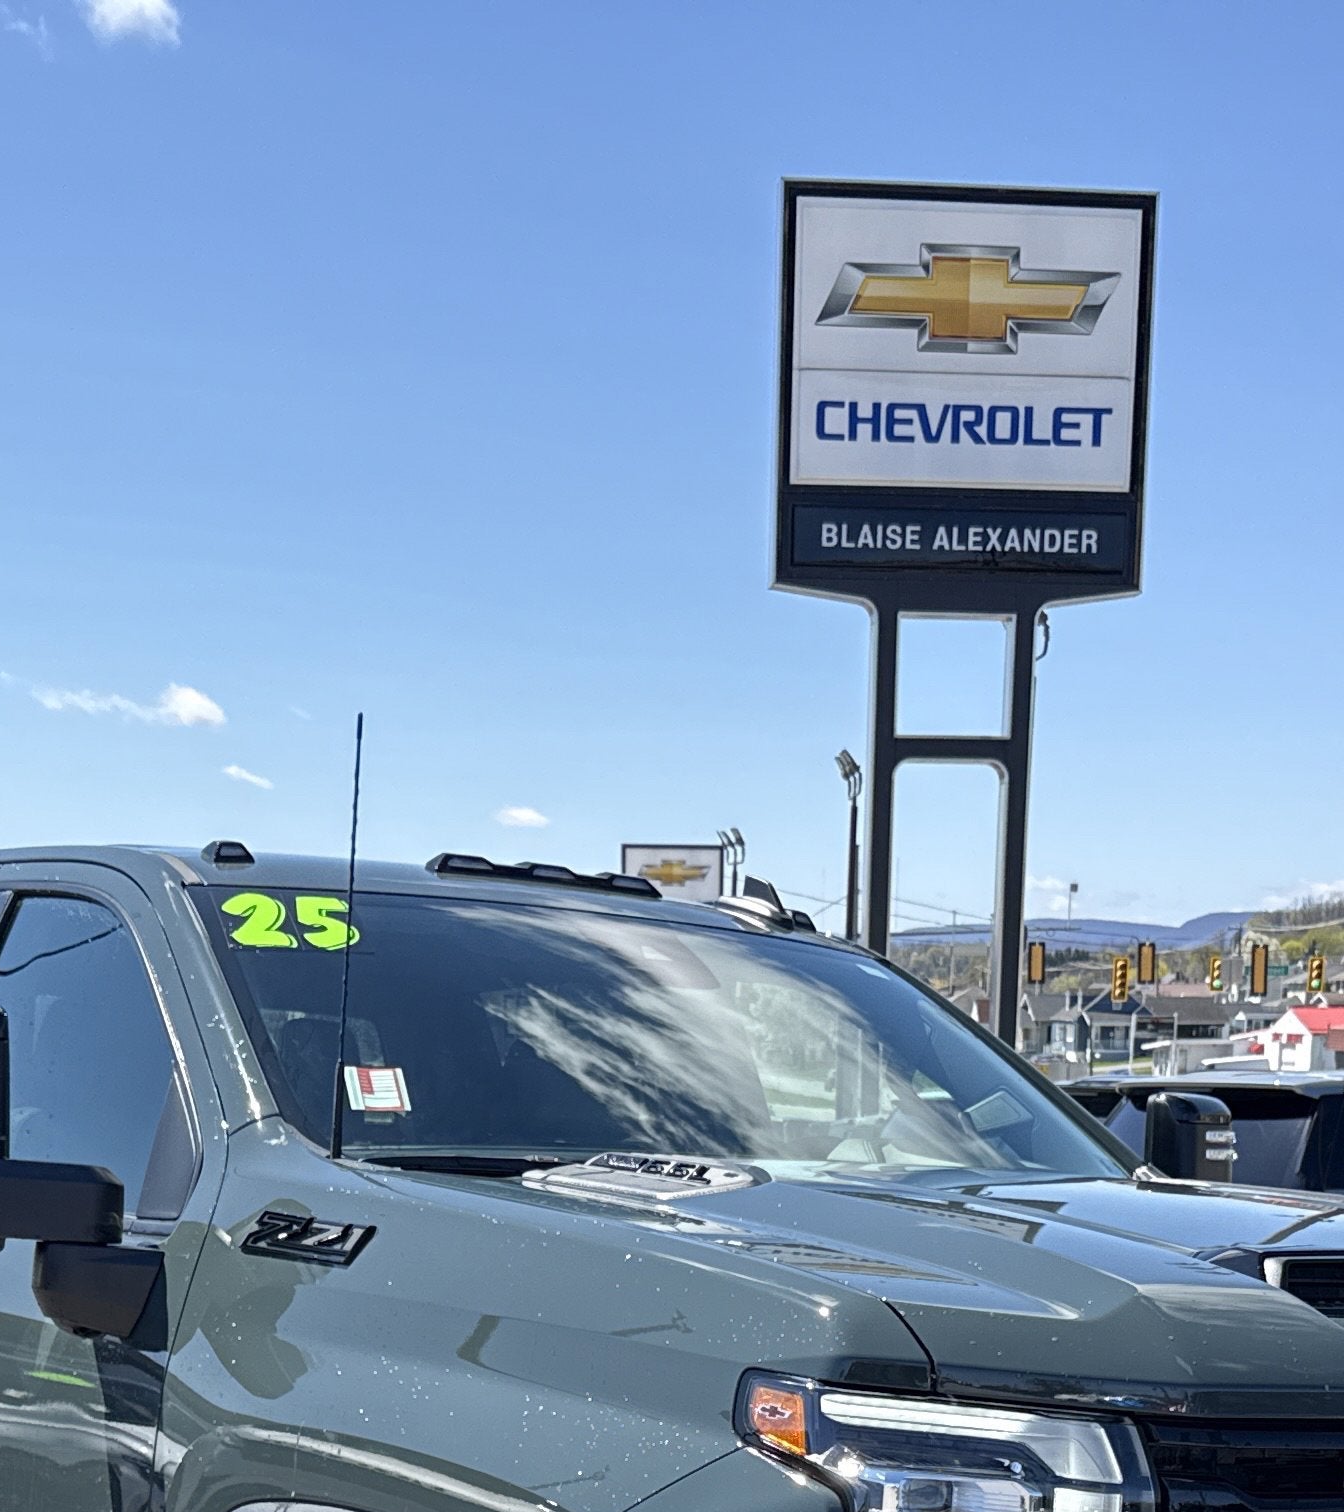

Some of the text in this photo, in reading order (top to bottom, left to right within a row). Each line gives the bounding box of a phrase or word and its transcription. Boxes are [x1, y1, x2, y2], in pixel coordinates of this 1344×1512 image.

[816, 400, 1113, 447] CHEVROLET
[821, 523, 1098, 554] BLAISE ALEXANDER
[221, 892, 360, 951] 25
[239, 1210, 377, 1269] Z71
